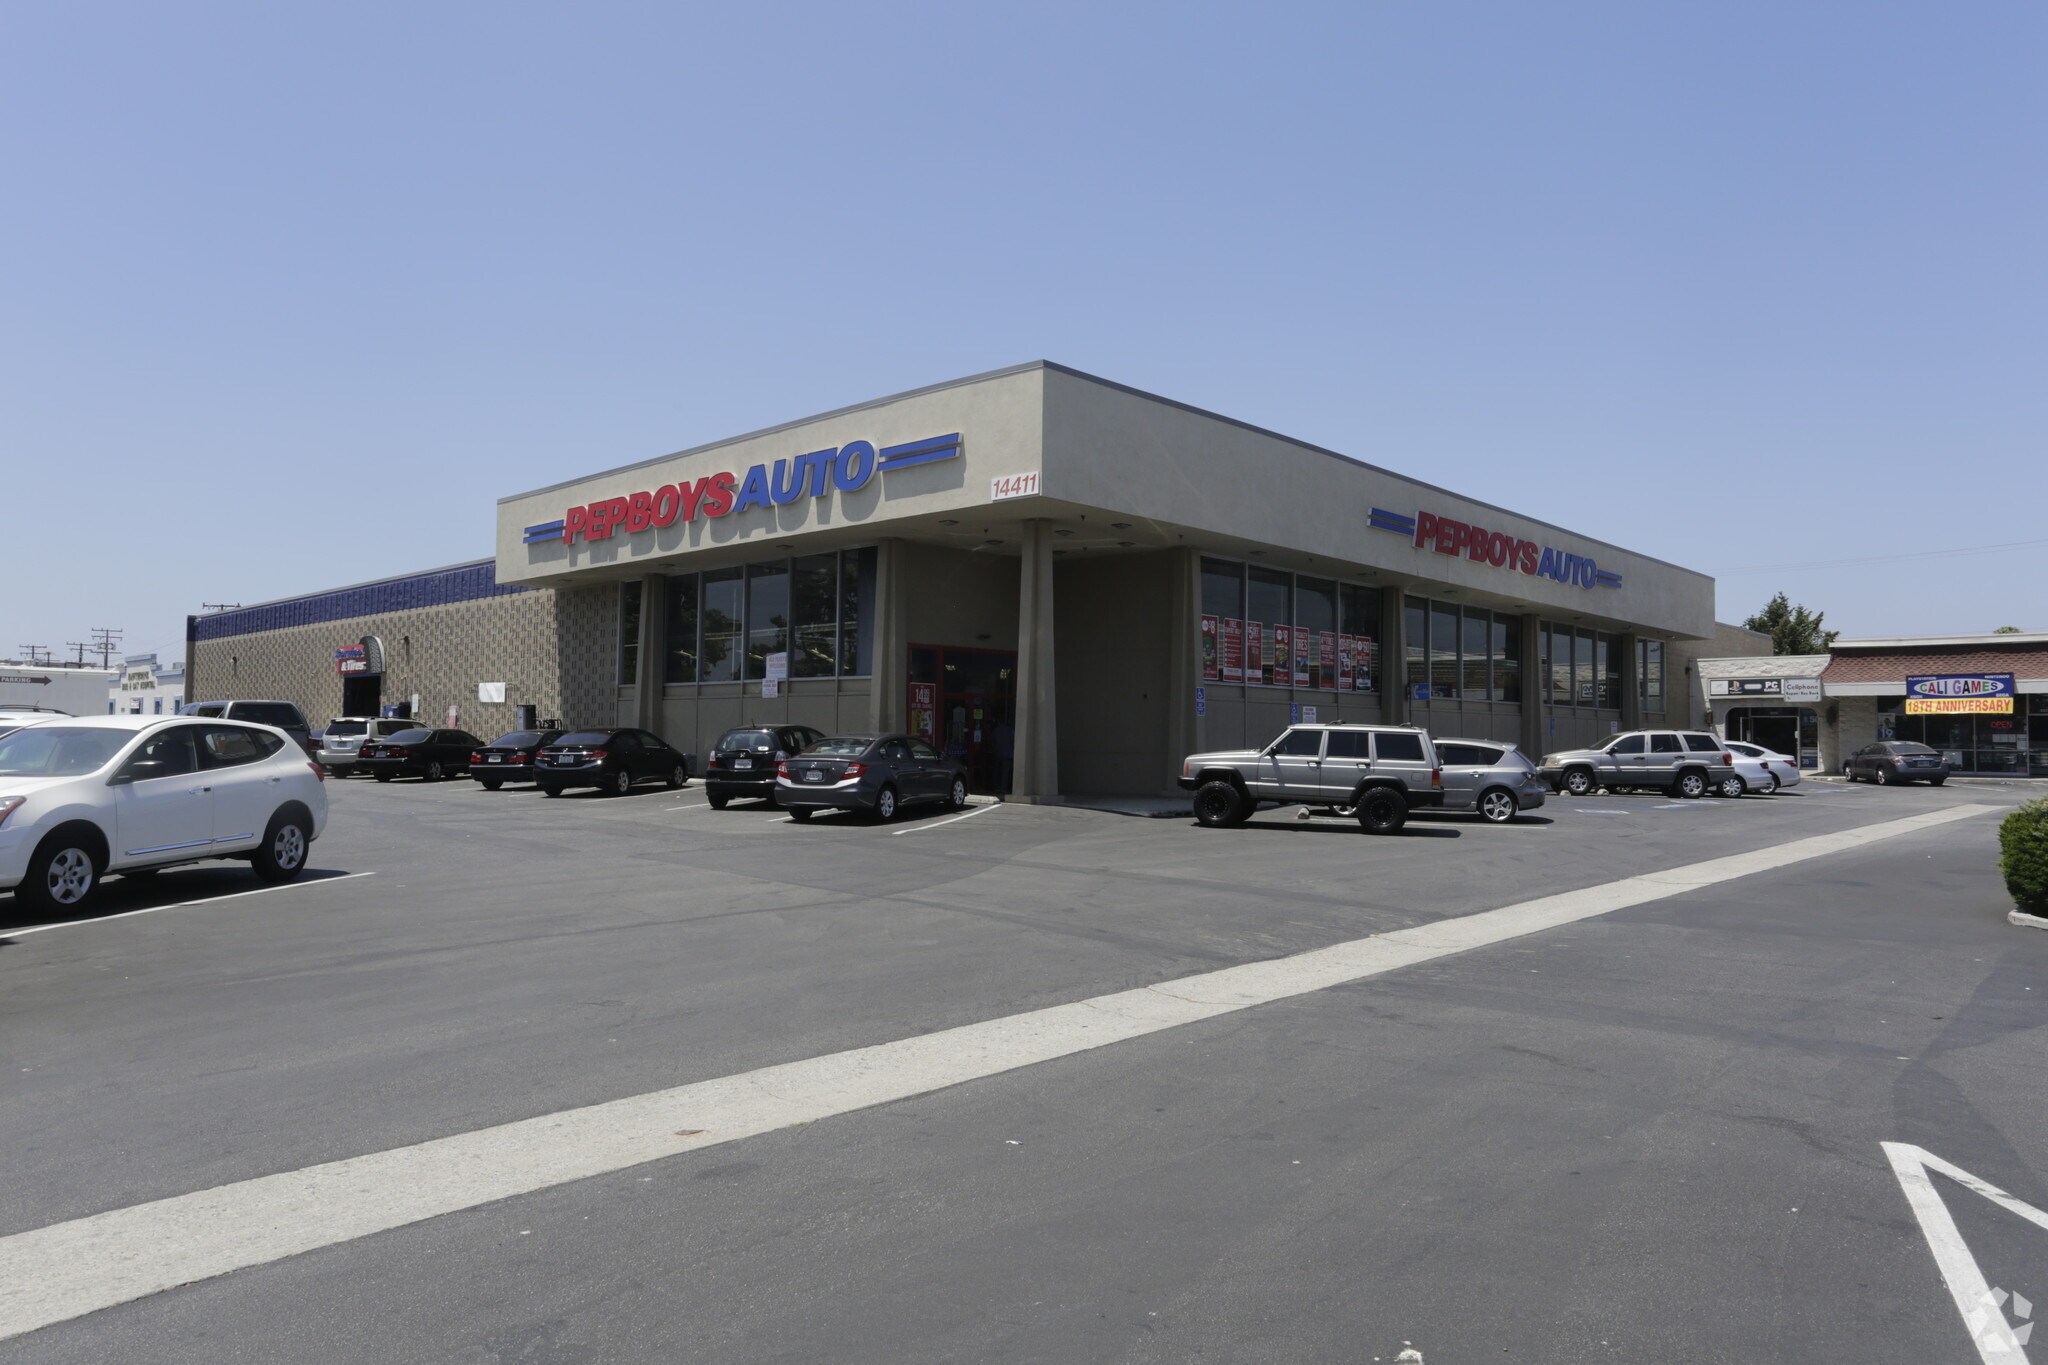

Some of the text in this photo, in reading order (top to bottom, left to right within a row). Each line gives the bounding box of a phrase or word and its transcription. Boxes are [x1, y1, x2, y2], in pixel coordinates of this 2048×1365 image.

[992, 474, 1037, 498] 14411
[1, 676, 31, 684] PARKING
[1920, 680, 1998, 694] CALI GAMES
[1908, 699, 2011, 713] 18TH ANNIVERSARY
